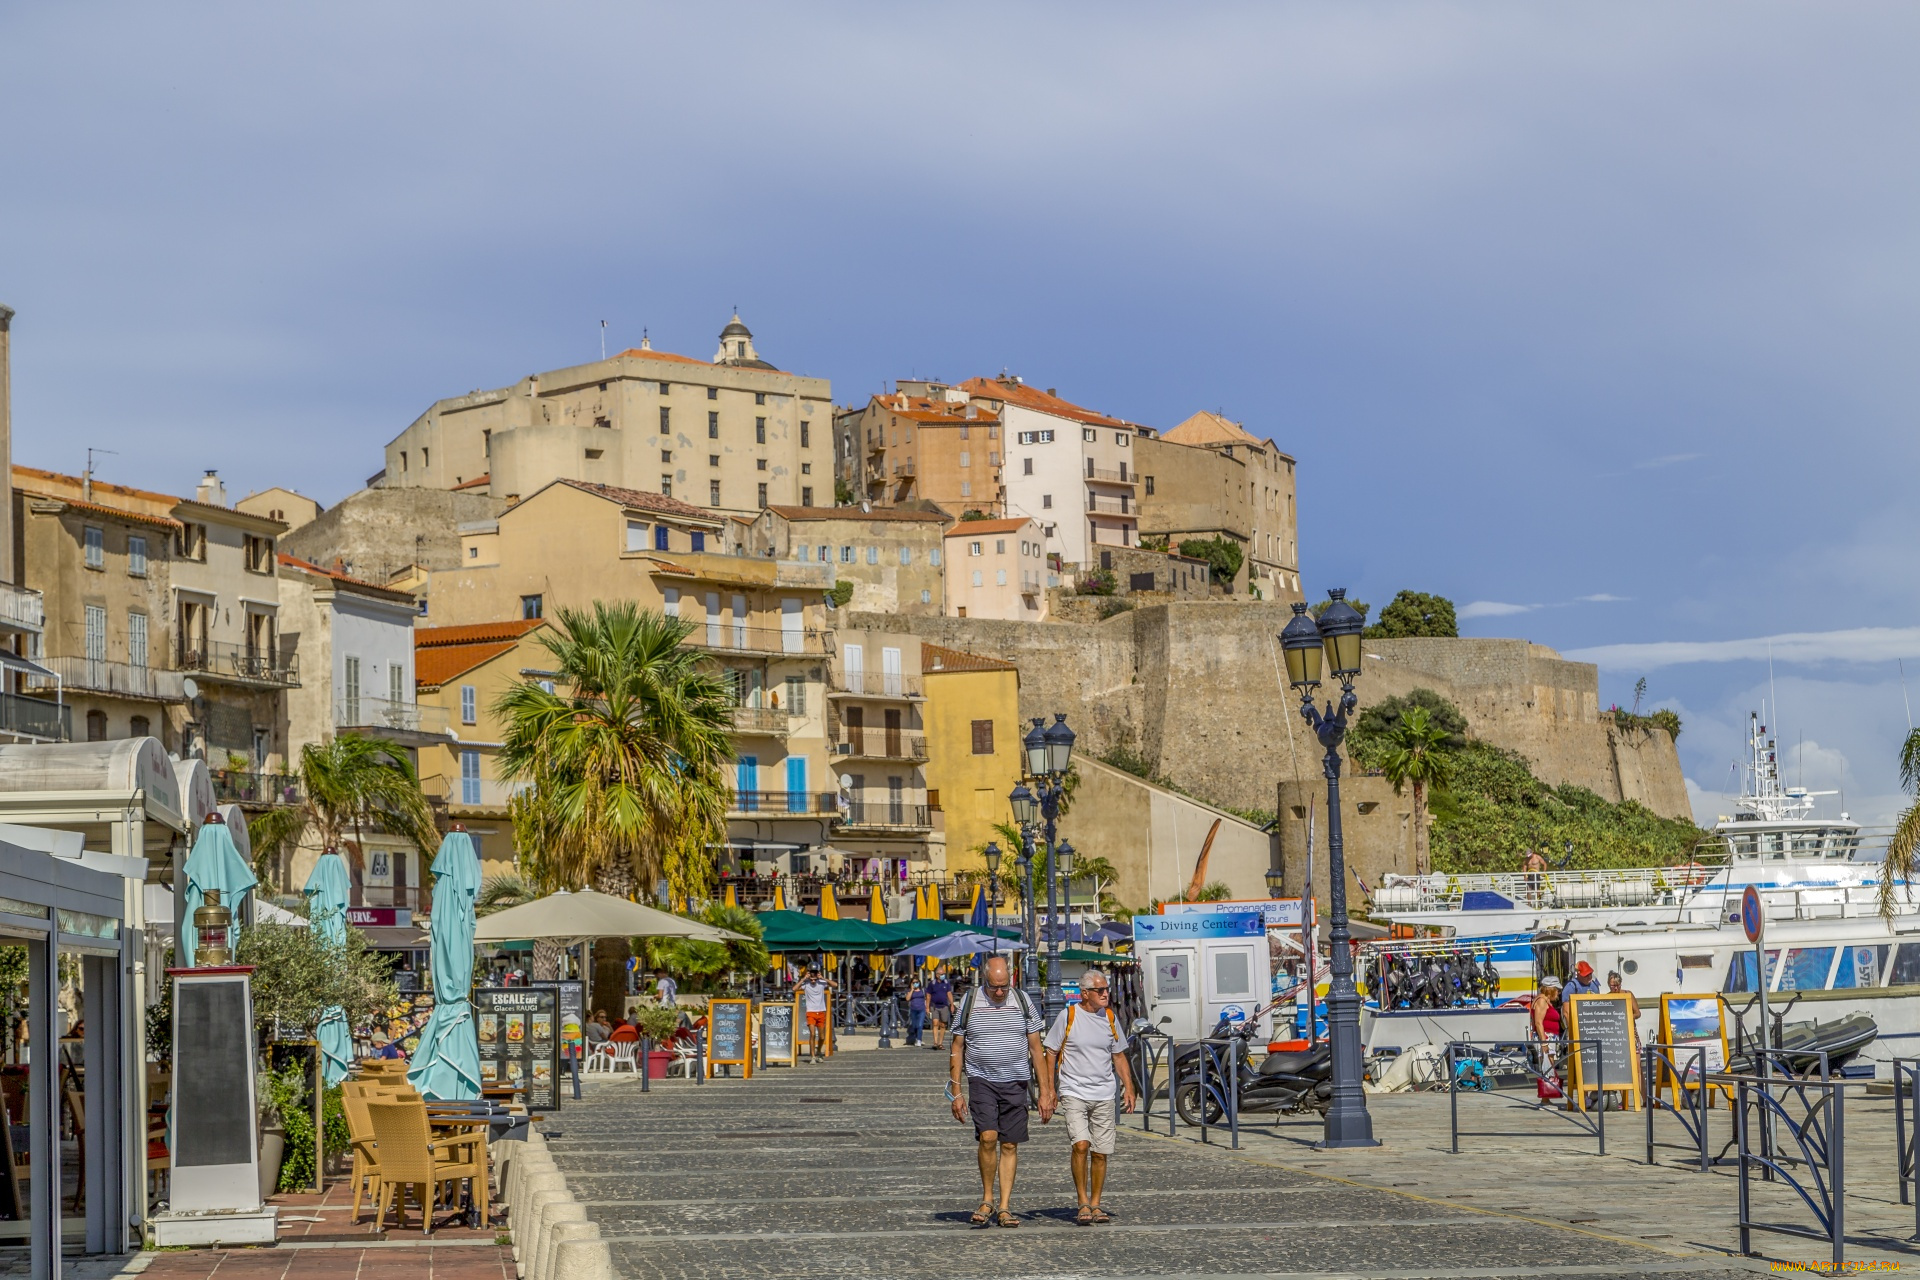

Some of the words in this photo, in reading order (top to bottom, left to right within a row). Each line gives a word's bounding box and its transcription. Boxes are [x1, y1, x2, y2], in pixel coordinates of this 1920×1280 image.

[1216, 902, 1277, 913] Promenades
[1280, 903, 1292, 912] en
[1266, 915, 1289, 923] tours
[1160, 920, 1199, 932] Diving
[1202, 918, 1238, 930] Center
[1160, 985, 1187, 994] Castille
[492, 993, 525, 1005] ESCALE
